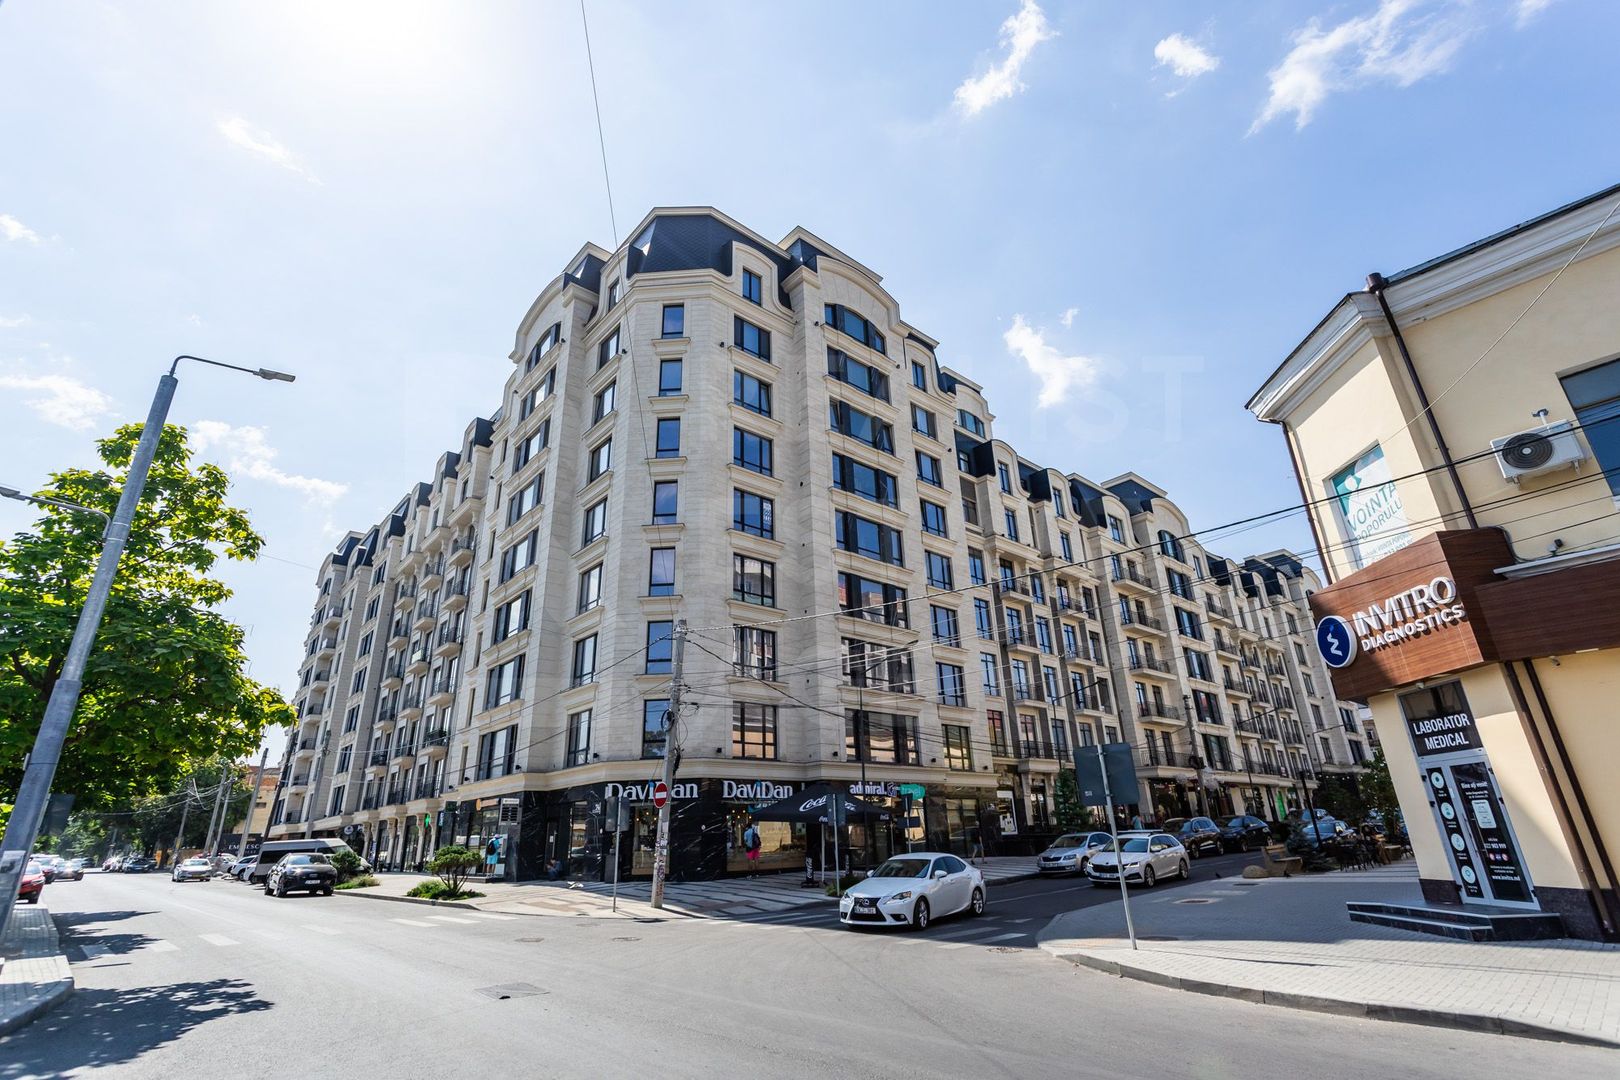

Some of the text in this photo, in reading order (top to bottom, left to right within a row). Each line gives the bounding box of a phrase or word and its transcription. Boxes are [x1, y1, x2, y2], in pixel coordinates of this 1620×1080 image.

[1352, 576, 1456, 637] INVITRO
[1361, 603, 1465, 652] DIAGNOSTICS
[1412, 713, 1471, 735] LABORATOR
[1424, 731, 1470, 750] MEDICAL
[605, 782, 699, 801] Davian
[723, 780, 793, 800] DaviDan
